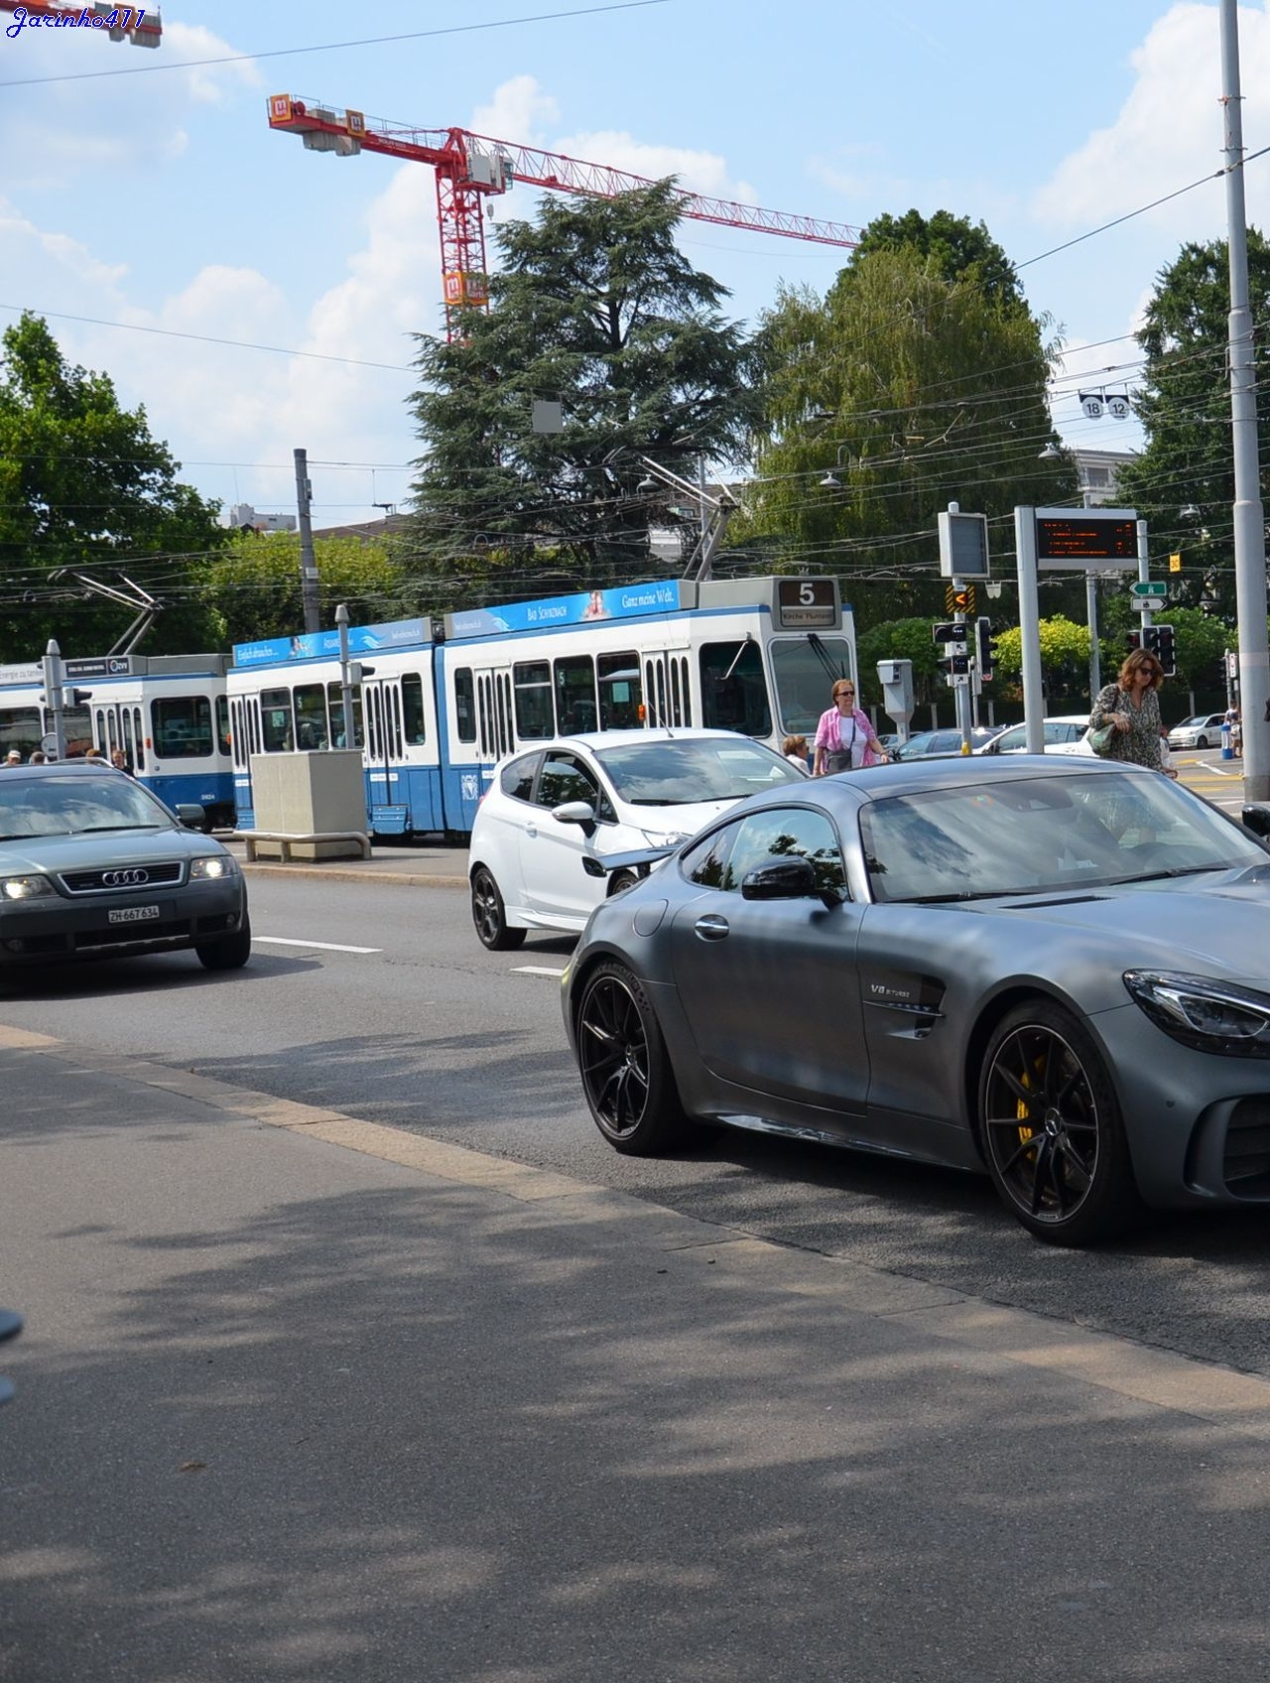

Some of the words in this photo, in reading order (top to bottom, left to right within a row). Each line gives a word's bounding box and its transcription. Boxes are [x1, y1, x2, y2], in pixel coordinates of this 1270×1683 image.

[1086, 402, 1101, 415] 18
[1112, 403, 1126, 415] 12
[621, 594, 638, 609] Ganz
[638, 591, 656, 606] meine
[799, 582, 815, 605] 5
[870, 984, 886, 994] V8
